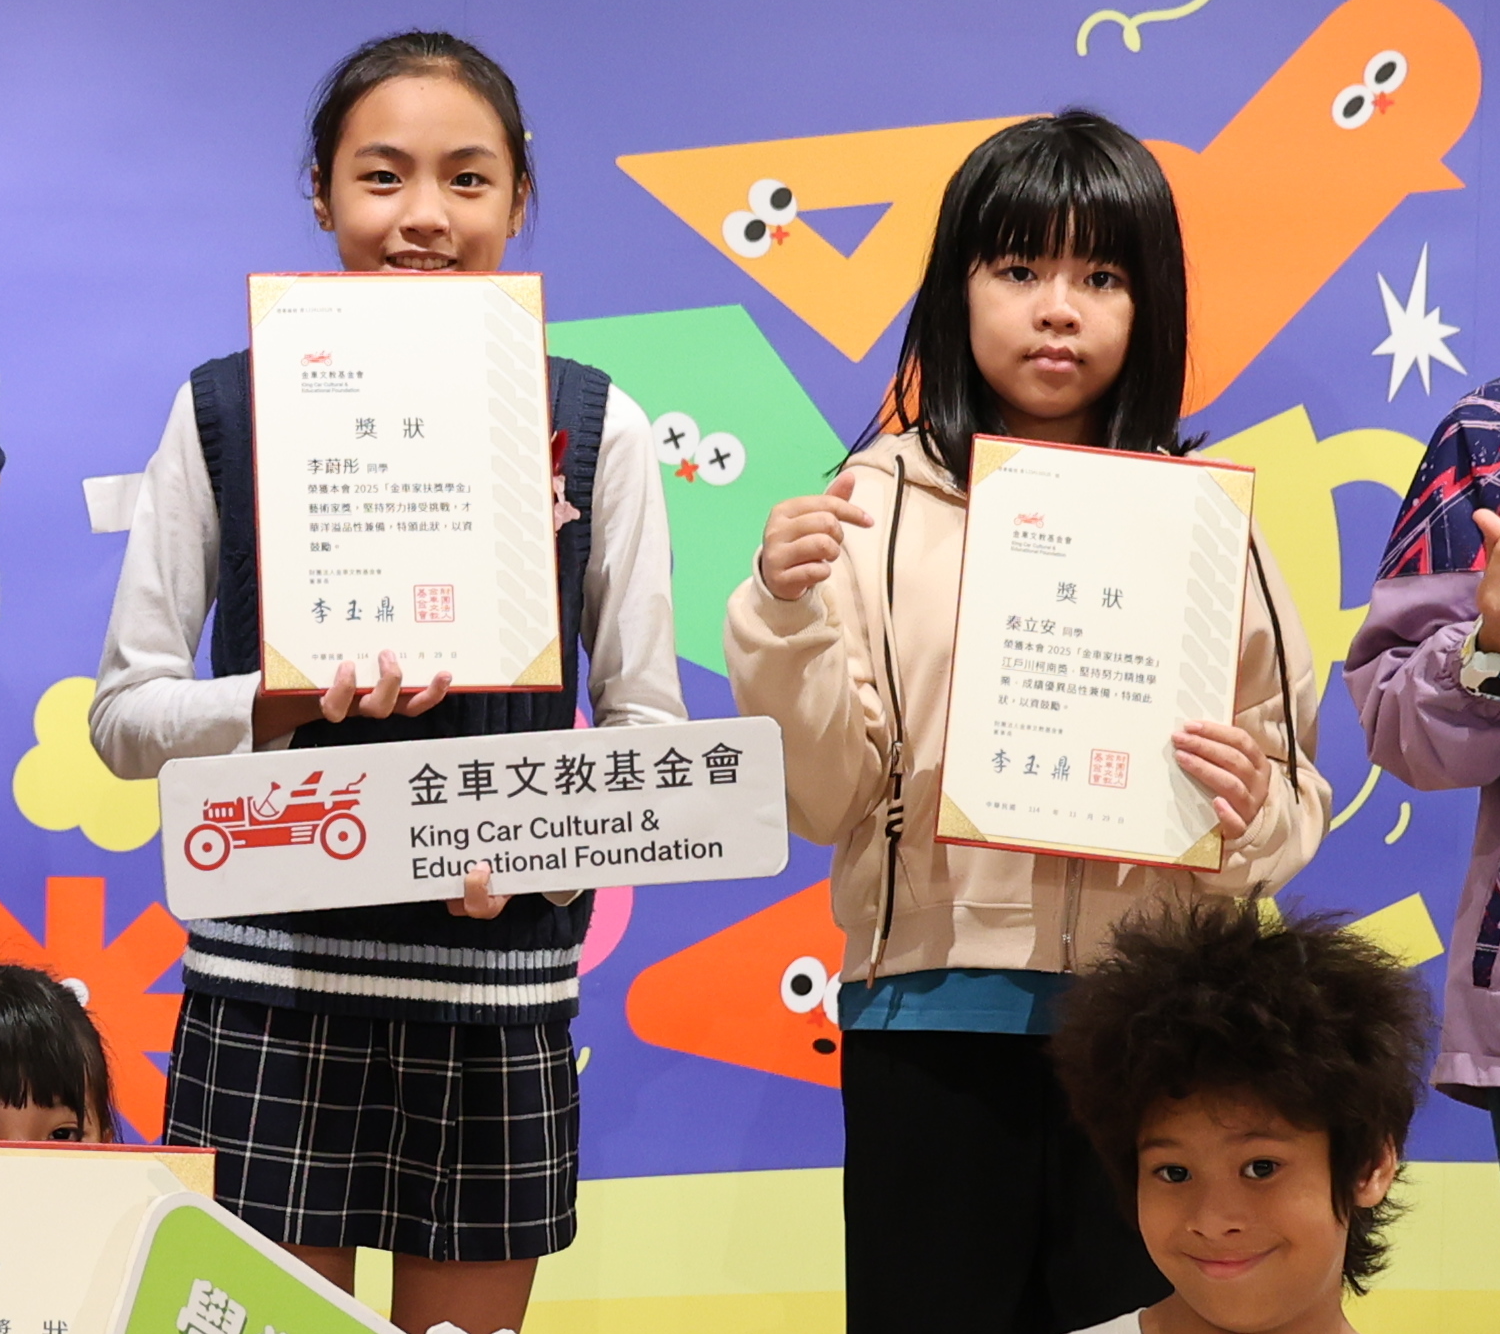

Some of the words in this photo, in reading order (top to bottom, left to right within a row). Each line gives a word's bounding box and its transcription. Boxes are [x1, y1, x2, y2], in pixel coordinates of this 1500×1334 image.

[367, 463, 389, 474] 同學
[1062, 626, 1083, 639] 同學
[408, 742, 744, 807] 金車文教基金會
[410, 823, 470, 853] King
[477, 820, 522, 844] Car
[529, 810, 632, 841] Cultural
[639, 809, 660, 832] &
[574, 838, 724, 870] Foundation
